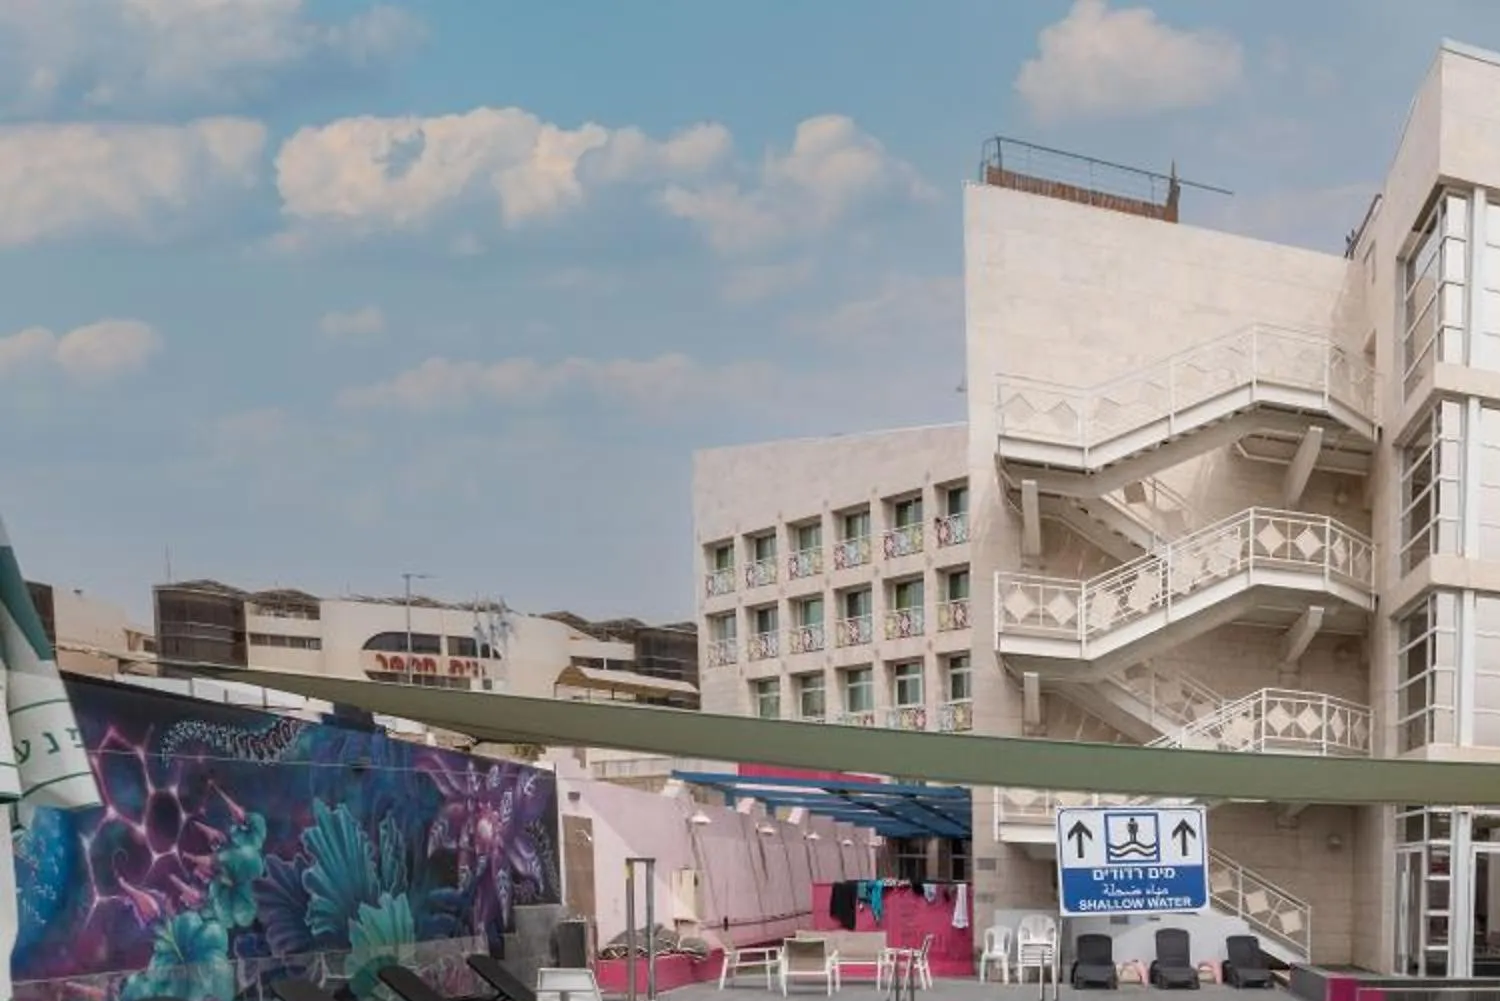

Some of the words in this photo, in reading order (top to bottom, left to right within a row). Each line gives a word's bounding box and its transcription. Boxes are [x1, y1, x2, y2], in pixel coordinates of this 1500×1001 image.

[1093, 868, 1143, 881] רדודים
[1148, 867, 1176, 880] מים
[1079, 898, 1146, 911] SHALLOW
[1147, 896, 1193, 909] WATER
